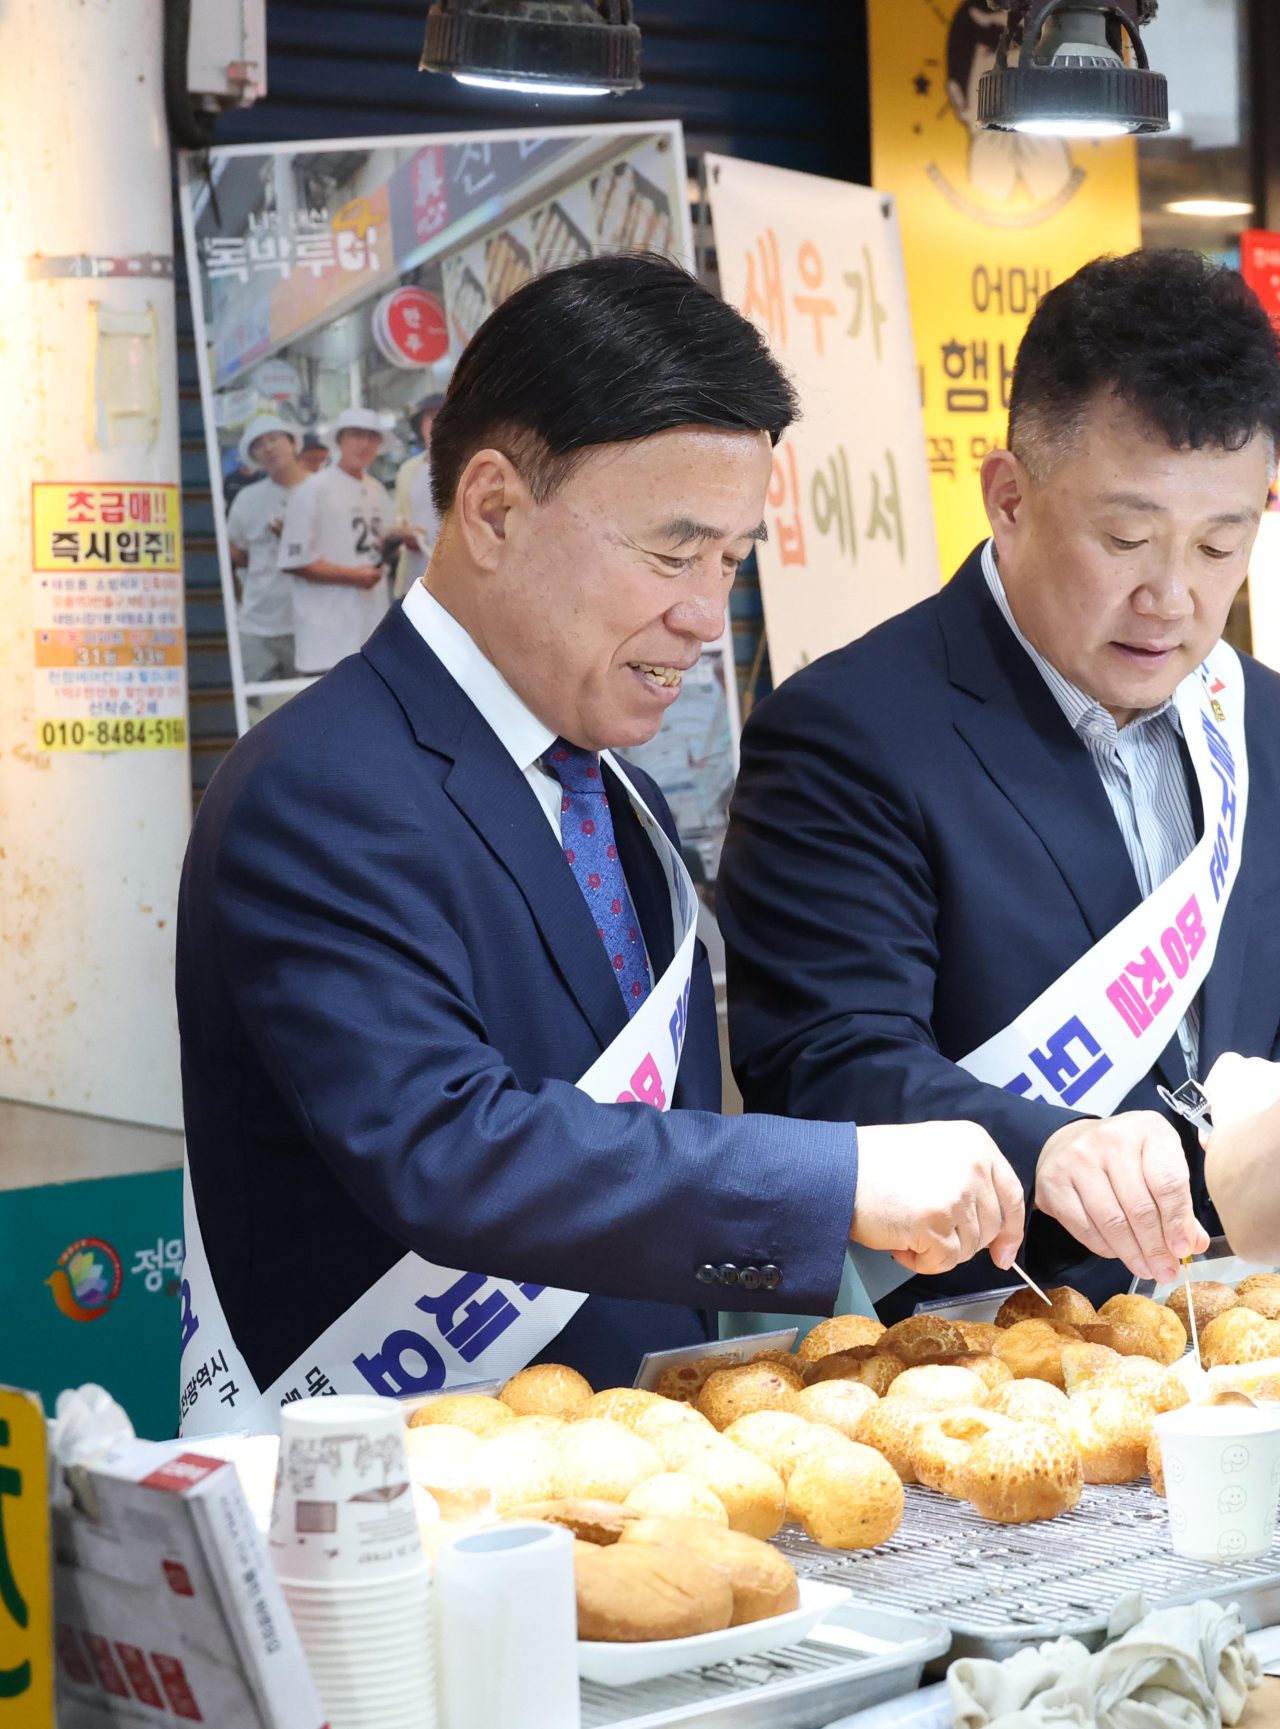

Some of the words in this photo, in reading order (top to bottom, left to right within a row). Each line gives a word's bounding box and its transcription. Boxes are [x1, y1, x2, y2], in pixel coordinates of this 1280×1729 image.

[741, 227, 888, 363] 새우가
[52, 531, 176, 564] 즉시입주!!
[67, 490, 167, 524] 초급매!!
[767, 438, 906, 567] 입에서
[1105, 893, 1208, 1039] 명절
[352, 1271, 547, 1398] 세요
